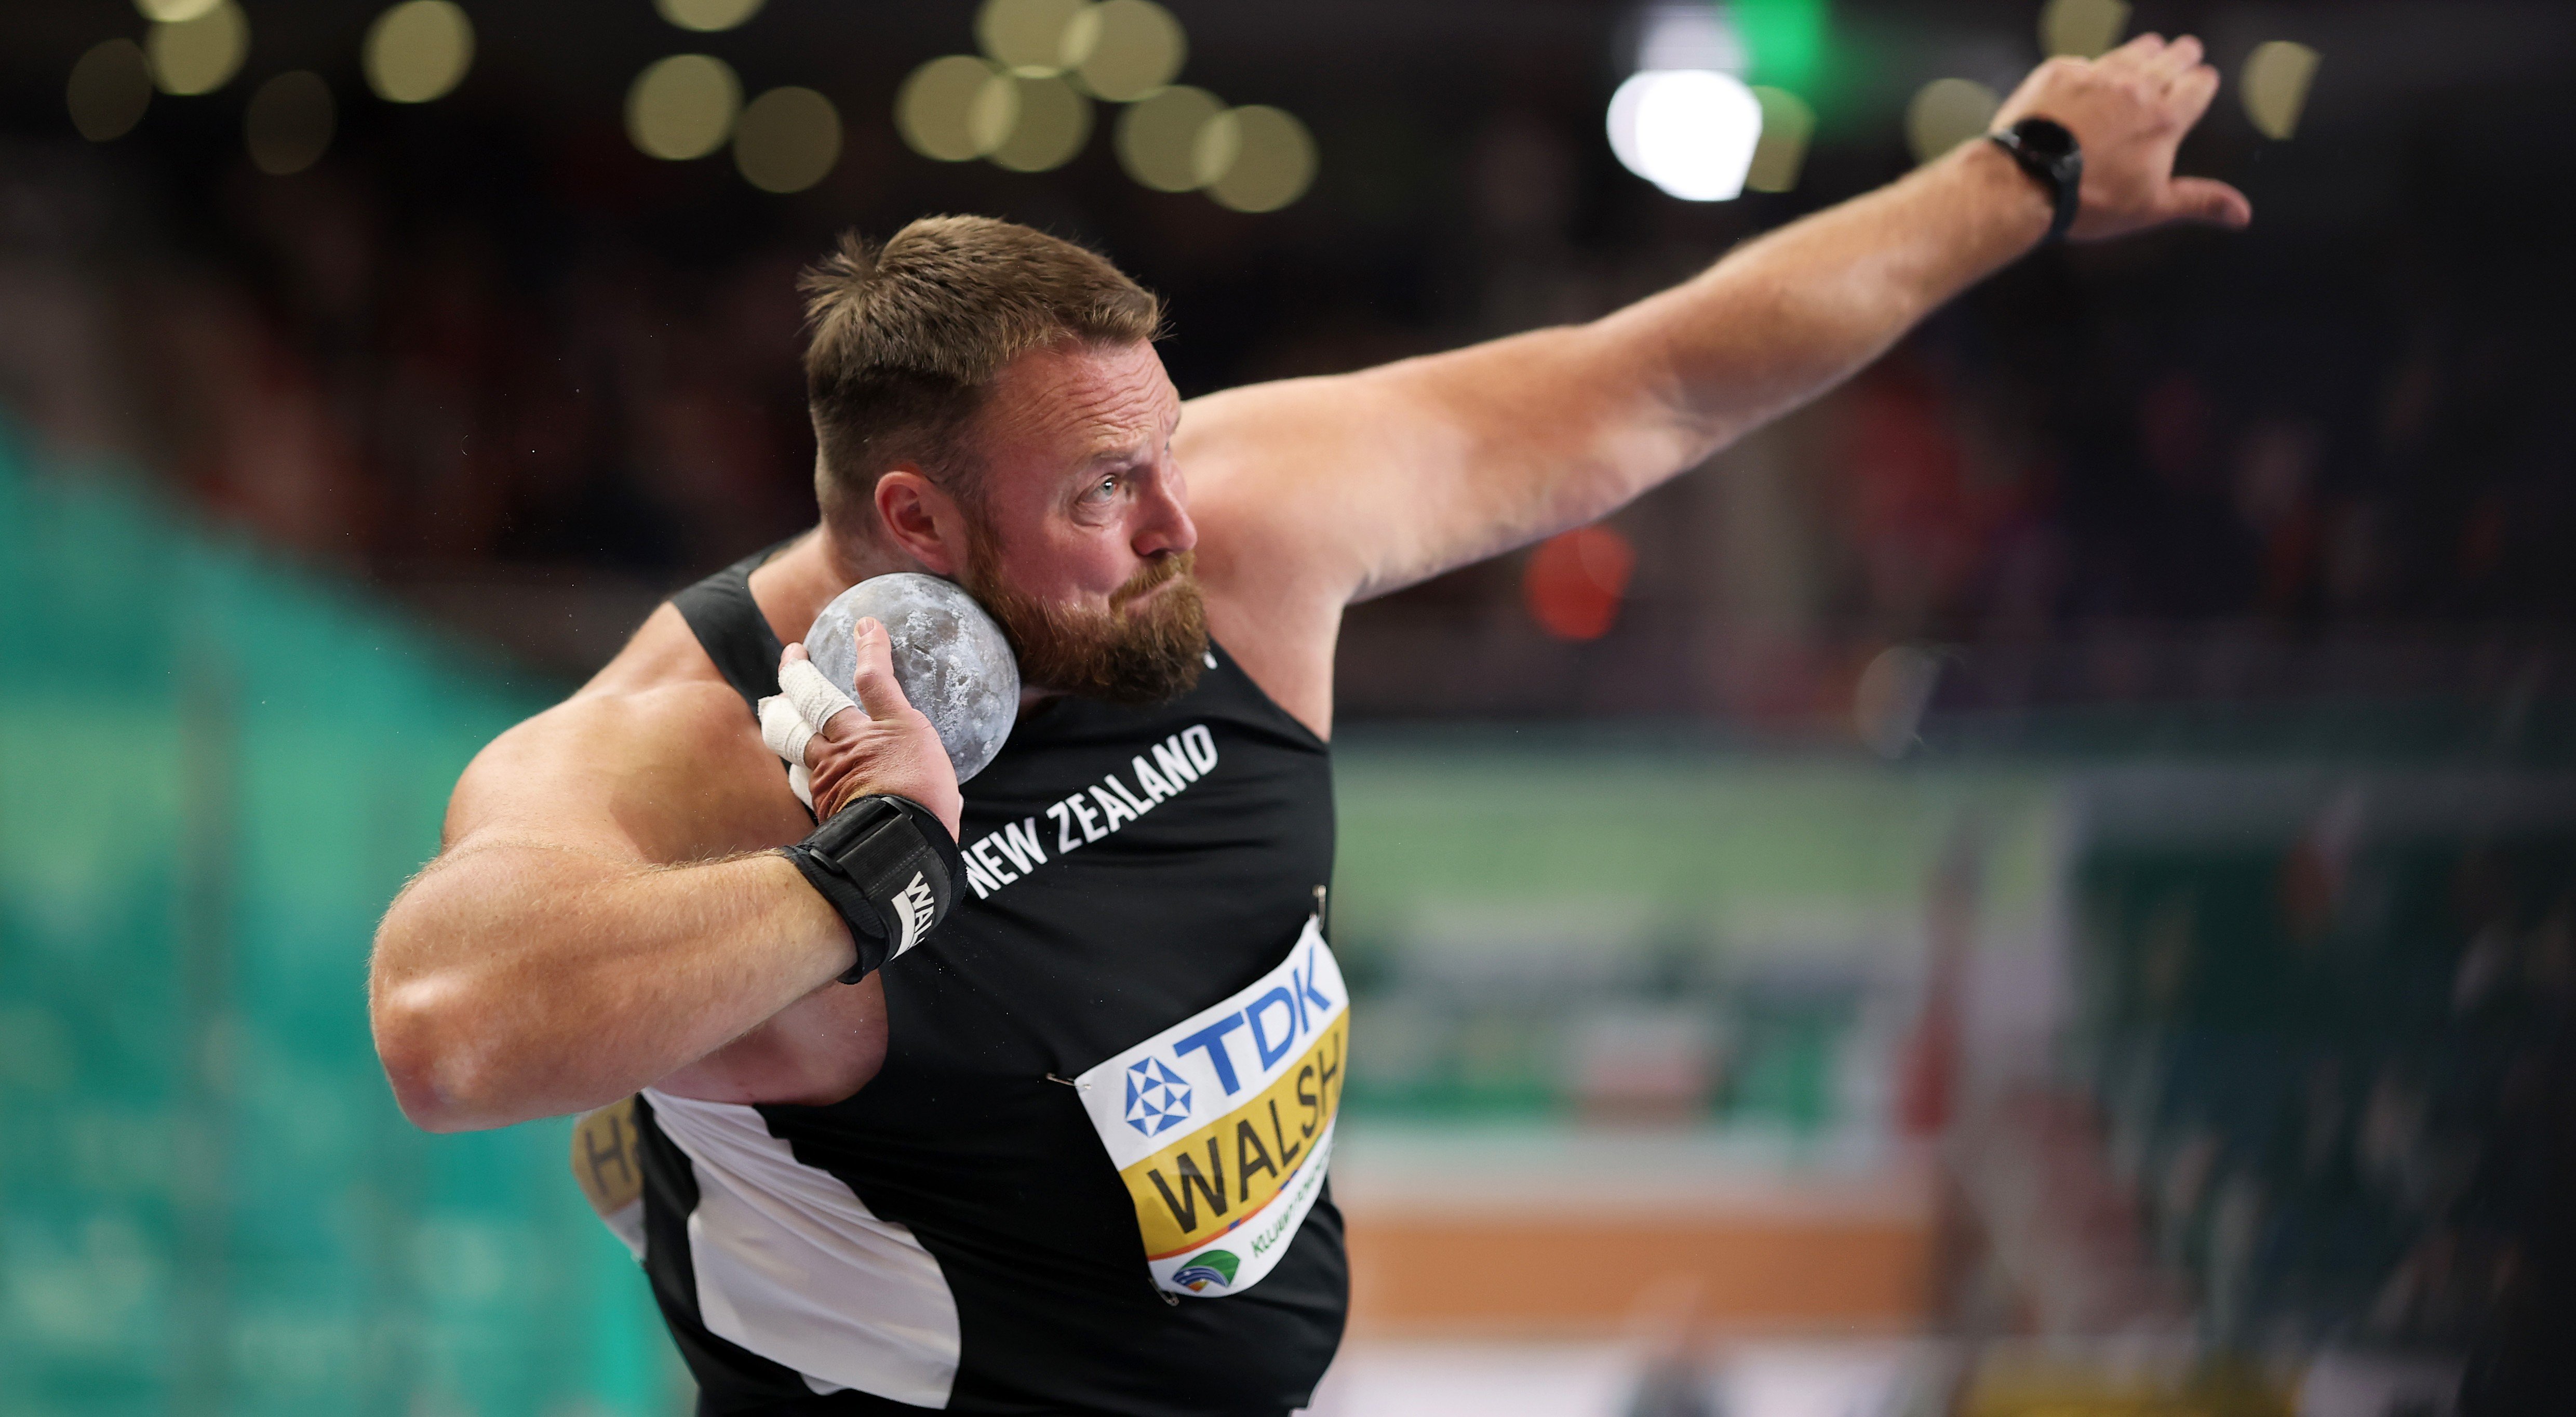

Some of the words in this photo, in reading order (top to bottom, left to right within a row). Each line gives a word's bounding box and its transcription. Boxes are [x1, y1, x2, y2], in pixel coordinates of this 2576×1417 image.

[961, 816, 1048, 900] NEW
[1046, 724, 1219, 854] ZEALAND
[904, 870, 934, 951] WAL
[1173, 942, 1332, 1097] TDK
[1147, 1031, 1340, 1235] WALSH
